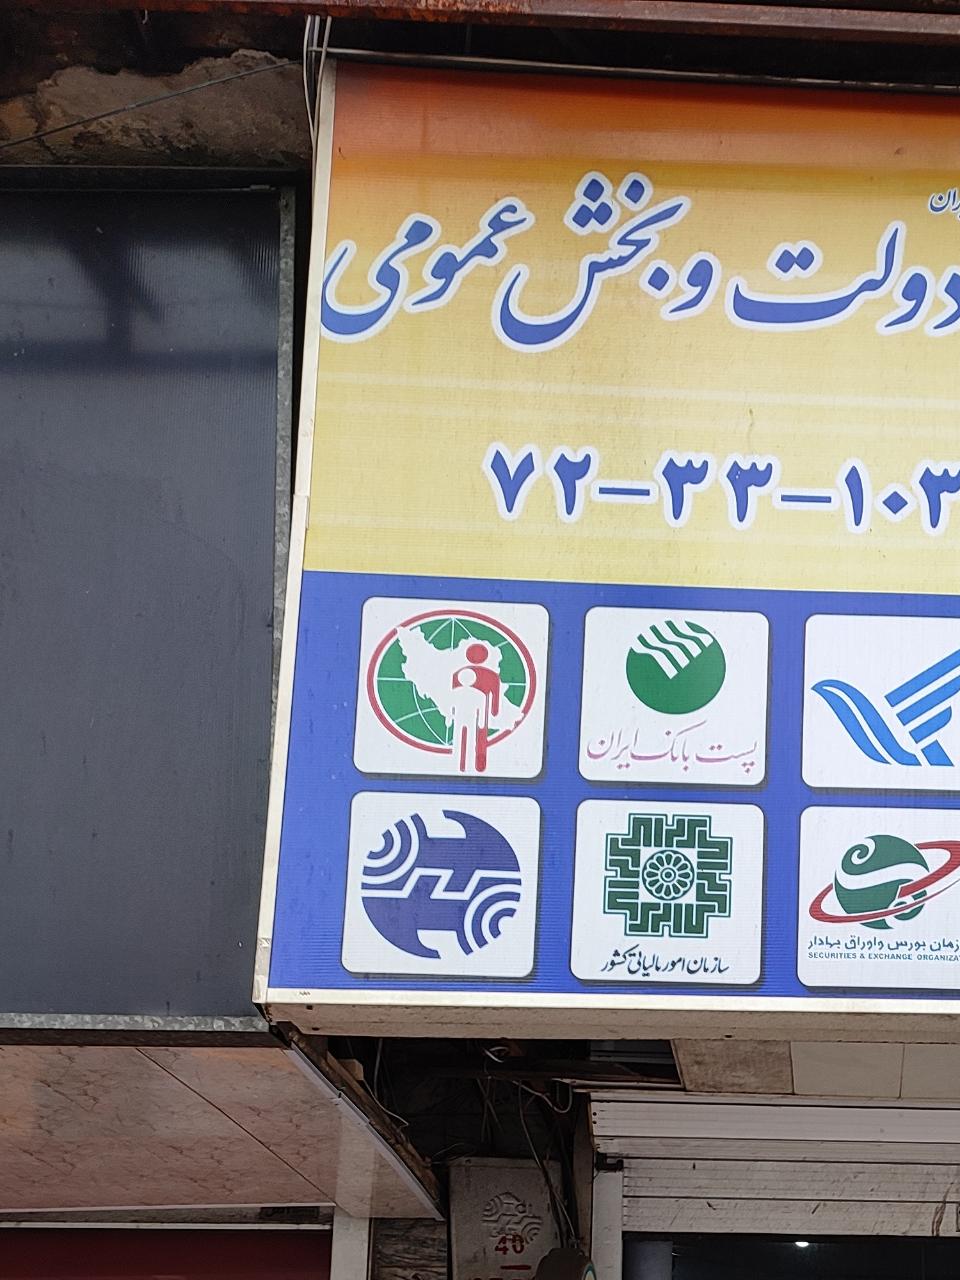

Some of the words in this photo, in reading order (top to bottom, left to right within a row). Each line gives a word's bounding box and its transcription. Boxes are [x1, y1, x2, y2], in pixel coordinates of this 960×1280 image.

[321, 202, 528, 334] عمومی
[502, 177, 686, 347] بخش
[586, 727, 639, 770] ایران
[633, 720, 707, 771] بانک
[694, 741, 758, 776] پست
[807, 935, 841, 949] بهادار
[807, 951, 857, 960] SECURITIES
[868, 952, 913, 961] EXCHANGE
[887, 938, 927, 951] بورس
[601, 944, 640, 972] کشور
[661, 957, 686, 972] امور
[686, 956, 731, 974] سازمان
